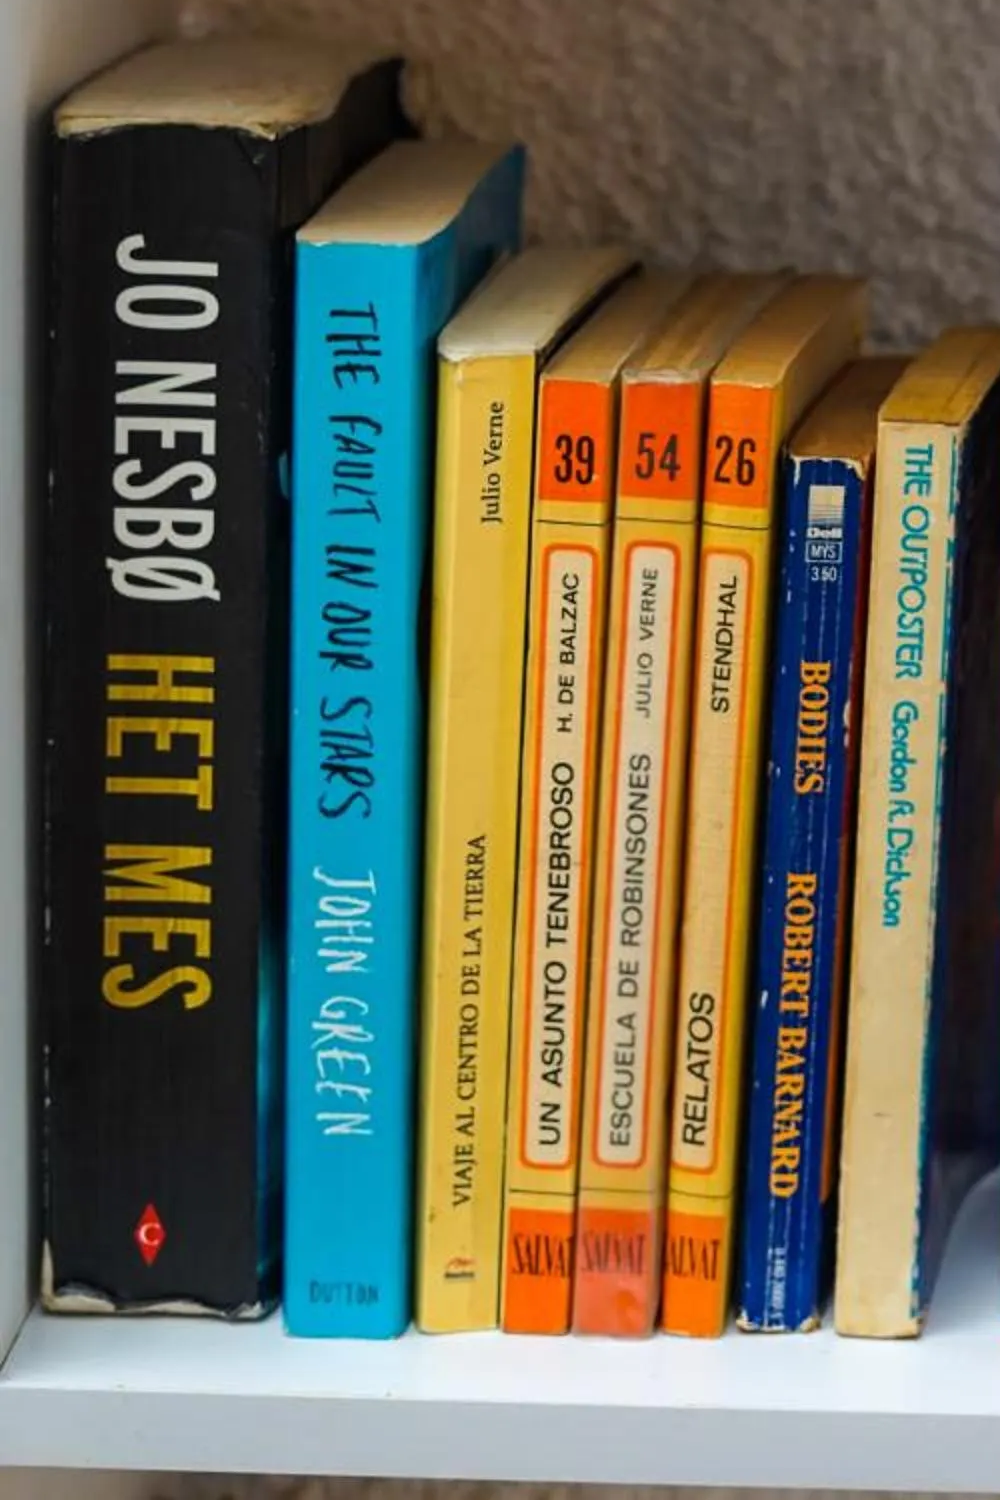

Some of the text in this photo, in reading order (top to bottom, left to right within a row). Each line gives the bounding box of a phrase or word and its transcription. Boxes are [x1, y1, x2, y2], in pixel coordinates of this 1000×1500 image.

[480, 401, 503, 524] Julio Verne
[555, 434, 596, 485] 39
[635, 433, 681, 482] 54
[714, 435, 756, 486] 26
[904, 443, 934, 496] THE
[102, 235, 221, 1009] JO NESBØ HET MES
[557, 572, 580, 734] H. DE BALZAC
[634, 569, 659, 719] JULIO VERNE
[712, 575, 738, 714] STENDHAL
[894, 505, 931, 681] OUTPOSTER
[312, 303, 382, 1137] THE FAULT IN OUR STARS JOHN GREEN
[887, 702, 918, 792] Gordon
[769, 661, 831, 1199] BODIES ROBERT BARNARD
[883, 824, 916, 926] Dickson
[451, 833, 487, 1207] VIAJE AL CENTRO DE LA TIERRA
[540, 761, 575, 1147] UN ASUNTO TENEBROSO
[610, 753, 651, 1148] ESCUELA DE ROBINSONES
[683, 992, 714, 1148] RELATOS
[666, 1238, 720, 1280] ALVAT
